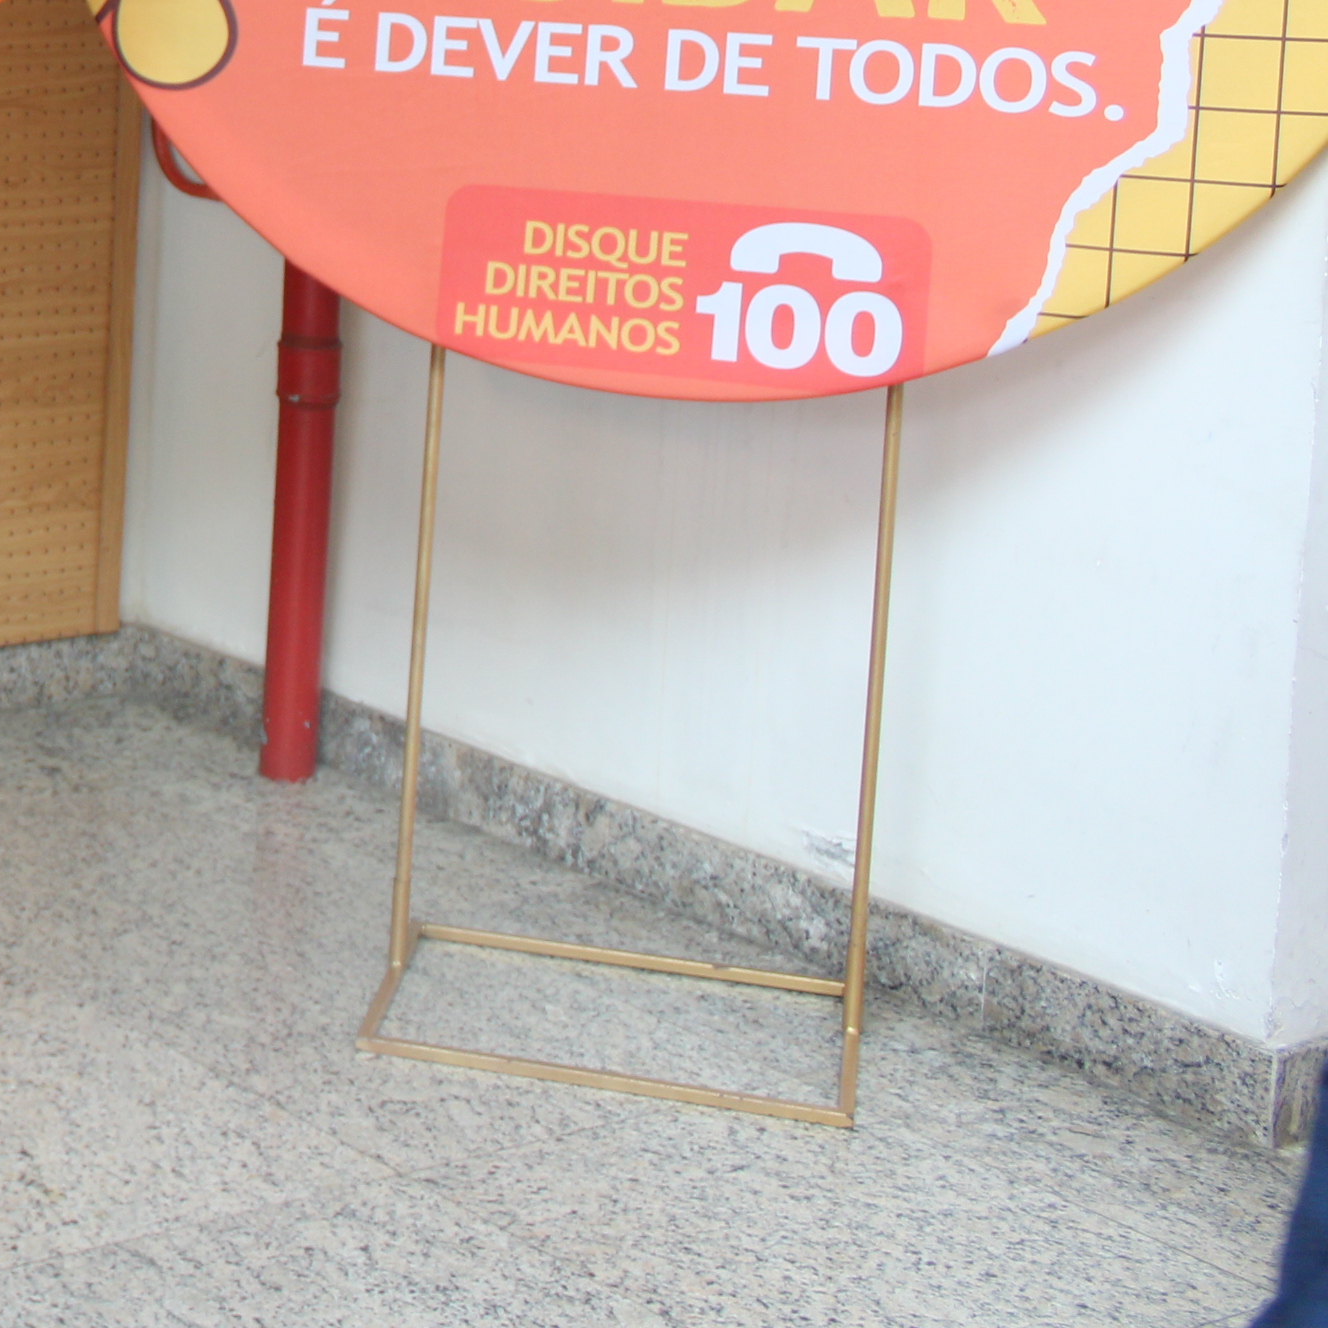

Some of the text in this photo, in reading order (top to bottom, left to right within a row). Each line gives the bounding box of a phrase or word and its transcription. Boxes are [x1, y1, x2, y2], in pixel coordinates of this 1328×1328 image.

[374, 12, 638, 89] DEVER
[664, 28, 773, 97] DE
[796, 36, 1126, 122] TODOS.
[524, 220, 689, 269] DISQUE
[486, 261, 685, 311] DIREITOS
[455, 302, 681, 355] HUMANOS
[695, 281, 903, 377] 100
